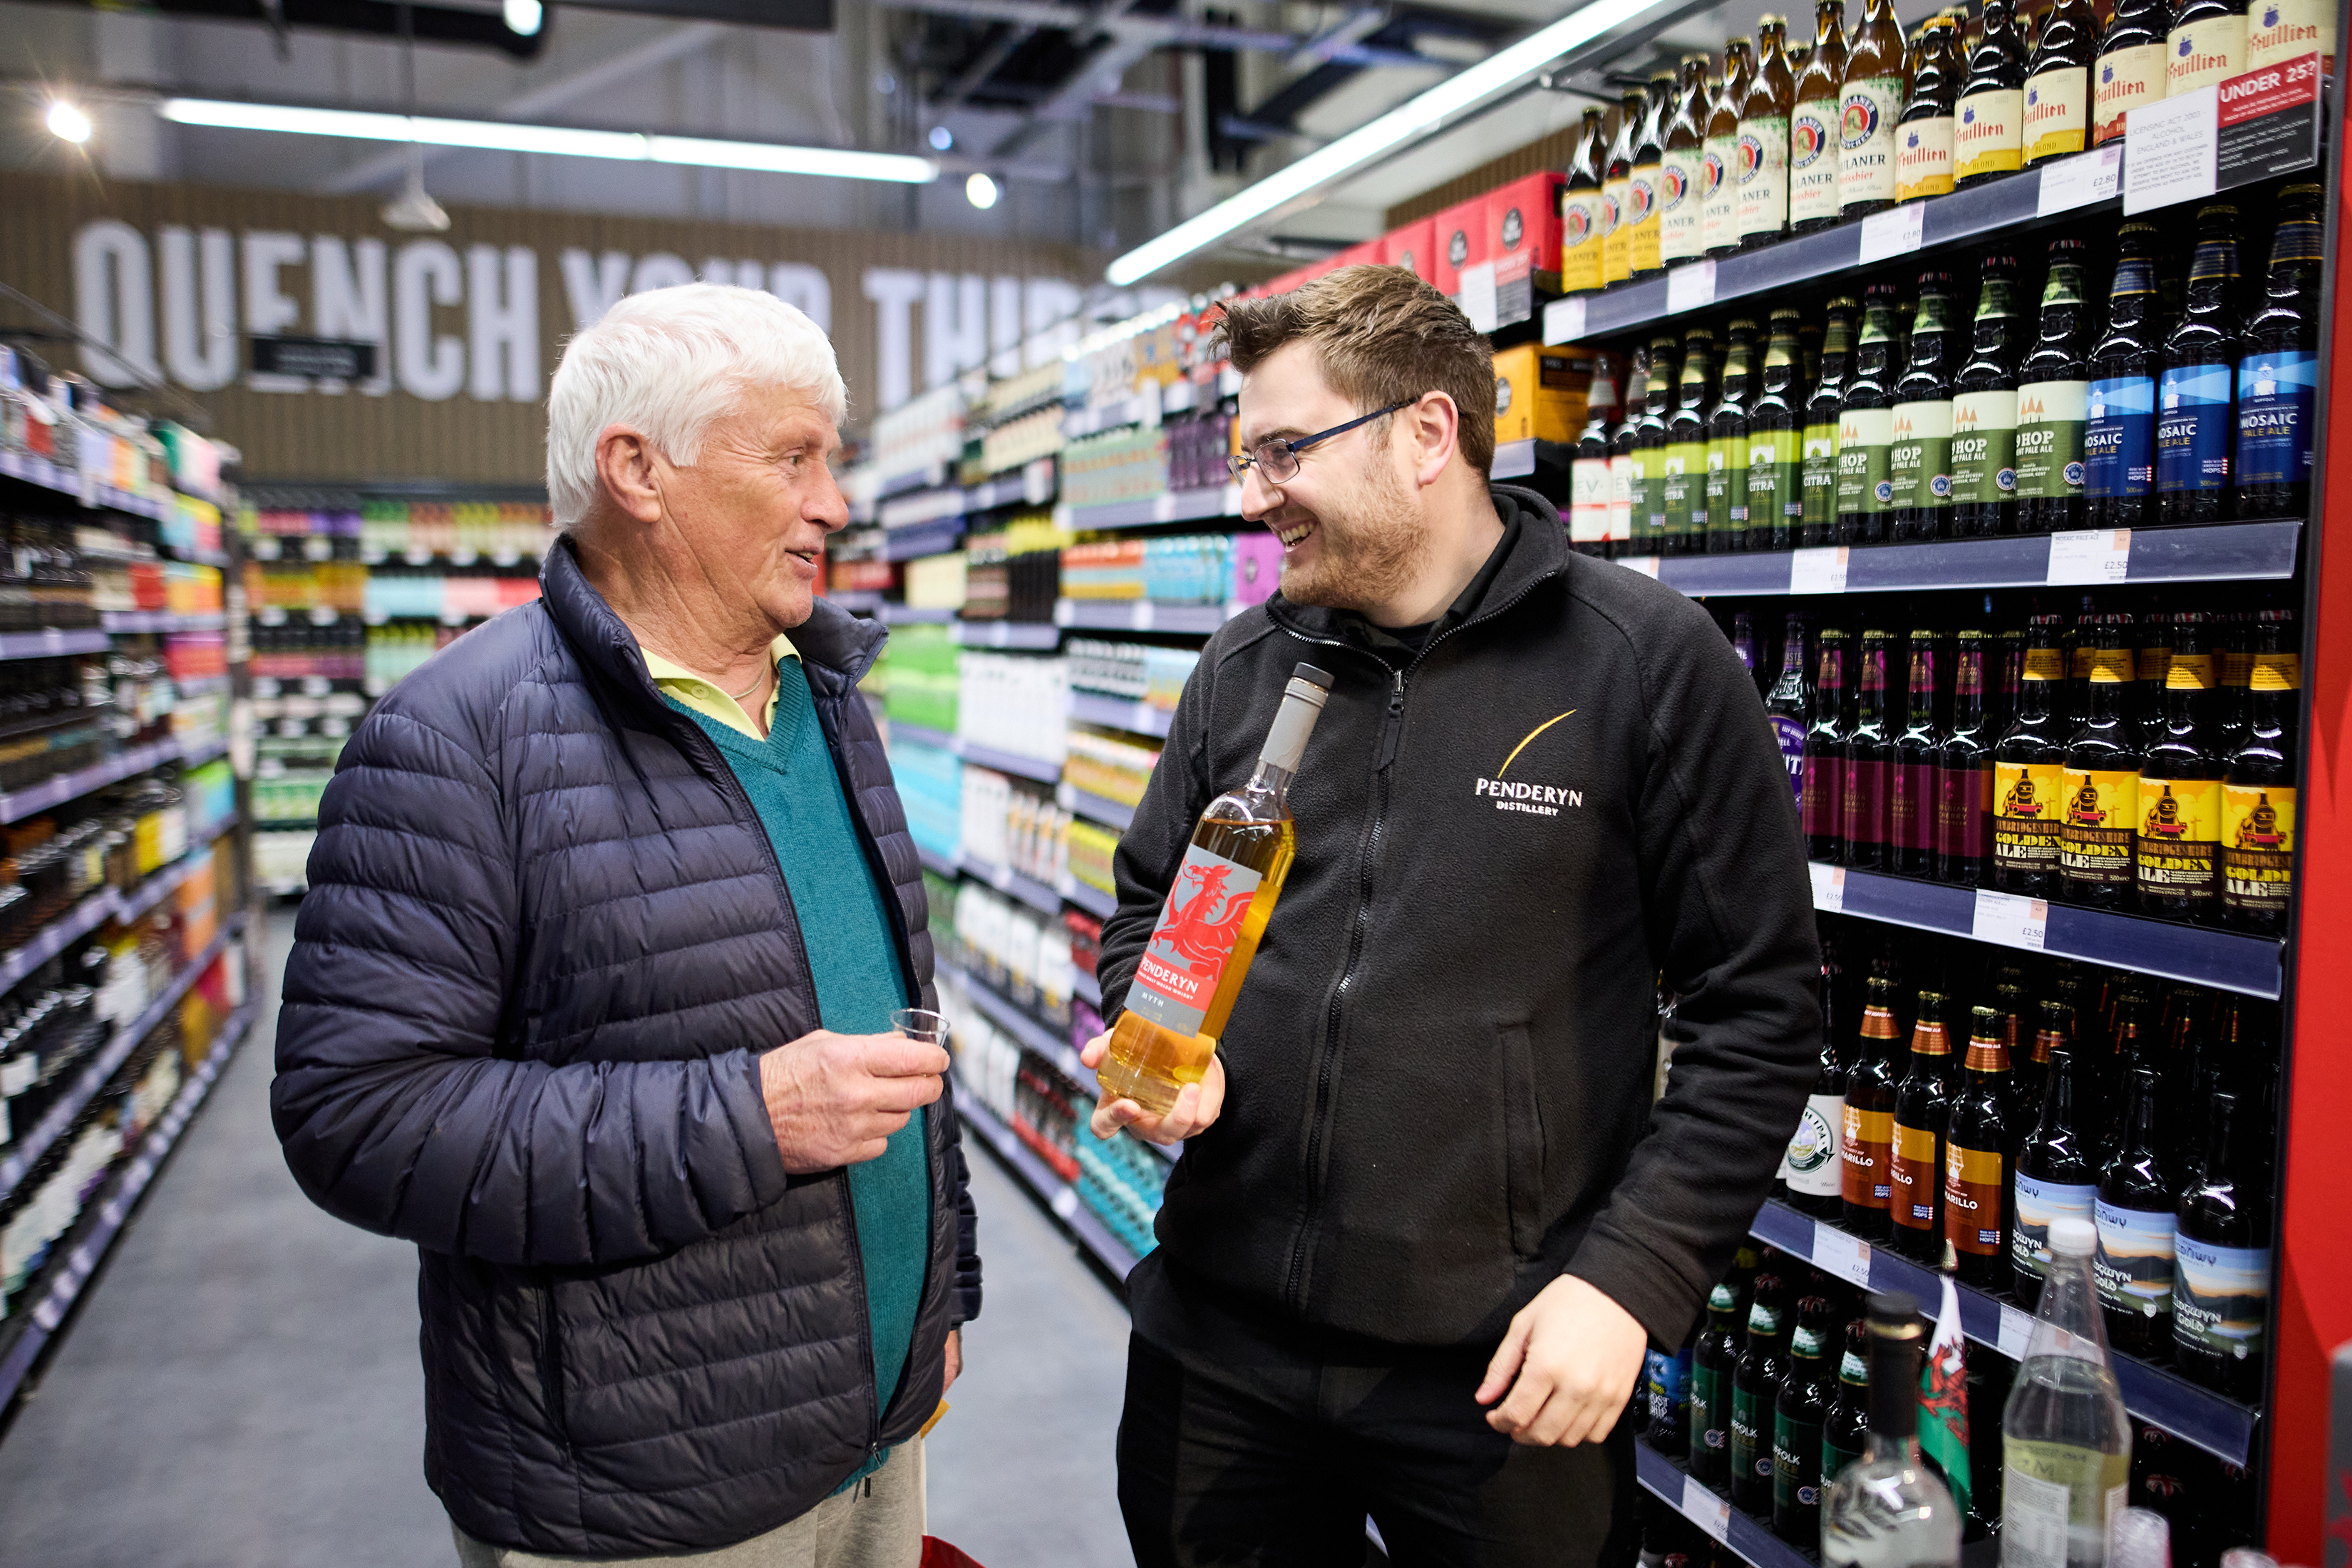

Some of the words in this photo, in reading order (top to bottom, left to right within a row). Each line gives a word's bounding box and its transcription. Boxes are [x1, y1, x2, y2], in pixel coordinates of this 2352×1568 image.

[2220, 73, 2281, 103] UNDER
[2286, 61, 2316, 83] 25?
[2129, 120, 2165, 136] LICENSING
[2168, 115, 2182, 125] ACT
[2184, 110, 2201, 121] 2003
[2152, 126, 2186, 140] ALCOHOL
[2137, 140, 2170, 155] ENGLAND
[2180, 130, 2204, 143] WALES
[2093, 174, 2116, 187] £2.80
[1742, 188, 1770, 203] ANER
[559, 247, 832, 336] YR
[73, 219, 540, 403] QUENCH
[2240, 413, 2298, 429] MOSAIC
[2021, 430, 2054, 447] HOP
[2242, 428, 2264, 437] PALE
[2268, 426, 2291, 435] ALE
[1956, 438, 1987, 454] HOP
[2025, 446, 2038, 455] PALE
[2040, 445, 2053, 453] ALE
[2099, 445, 2117, 455] ALE
[2159, 438, 2170, 448] ALE
[2172, 437, 2190, 445] ALE
[1841, 452, 1867, 468] HOP
[1894, 446, 1922, 461] HOP
[1974, 452, 1986, 460] ALE
[1855, 465, 1866, 474] ALE
[1909, 460, 1921, 468] ALE
[1749, 479, 1775, 492] CITRA
[1804, 474, 1832, 487] CITRA
[2105, 561, 2127, 569] £2.50
[1785, 652, 1802, 661] ASTE
[1475, 778, 1583, 808] PENDERYN
[1496, 800, 1559, 817] DISTILLERY
[1995, 843, 2027, 859] ALE
[2061, 840, 2130, 857] GOLDEN
[2061, 852, 2090, 869] ALE
[2137, 854, 2212, 871] GOLDEN
[2137, 866, 2170, 884] ALE
[2224, 878, 2268, 897] ALE
[2022, 927, 2043, 939] £2.50
[1140, 956, 1199, 994] PENDERYN
[1142, 991, 1165, 1008] MYTH
[1814, 1120, 1826, 1139] IPA
